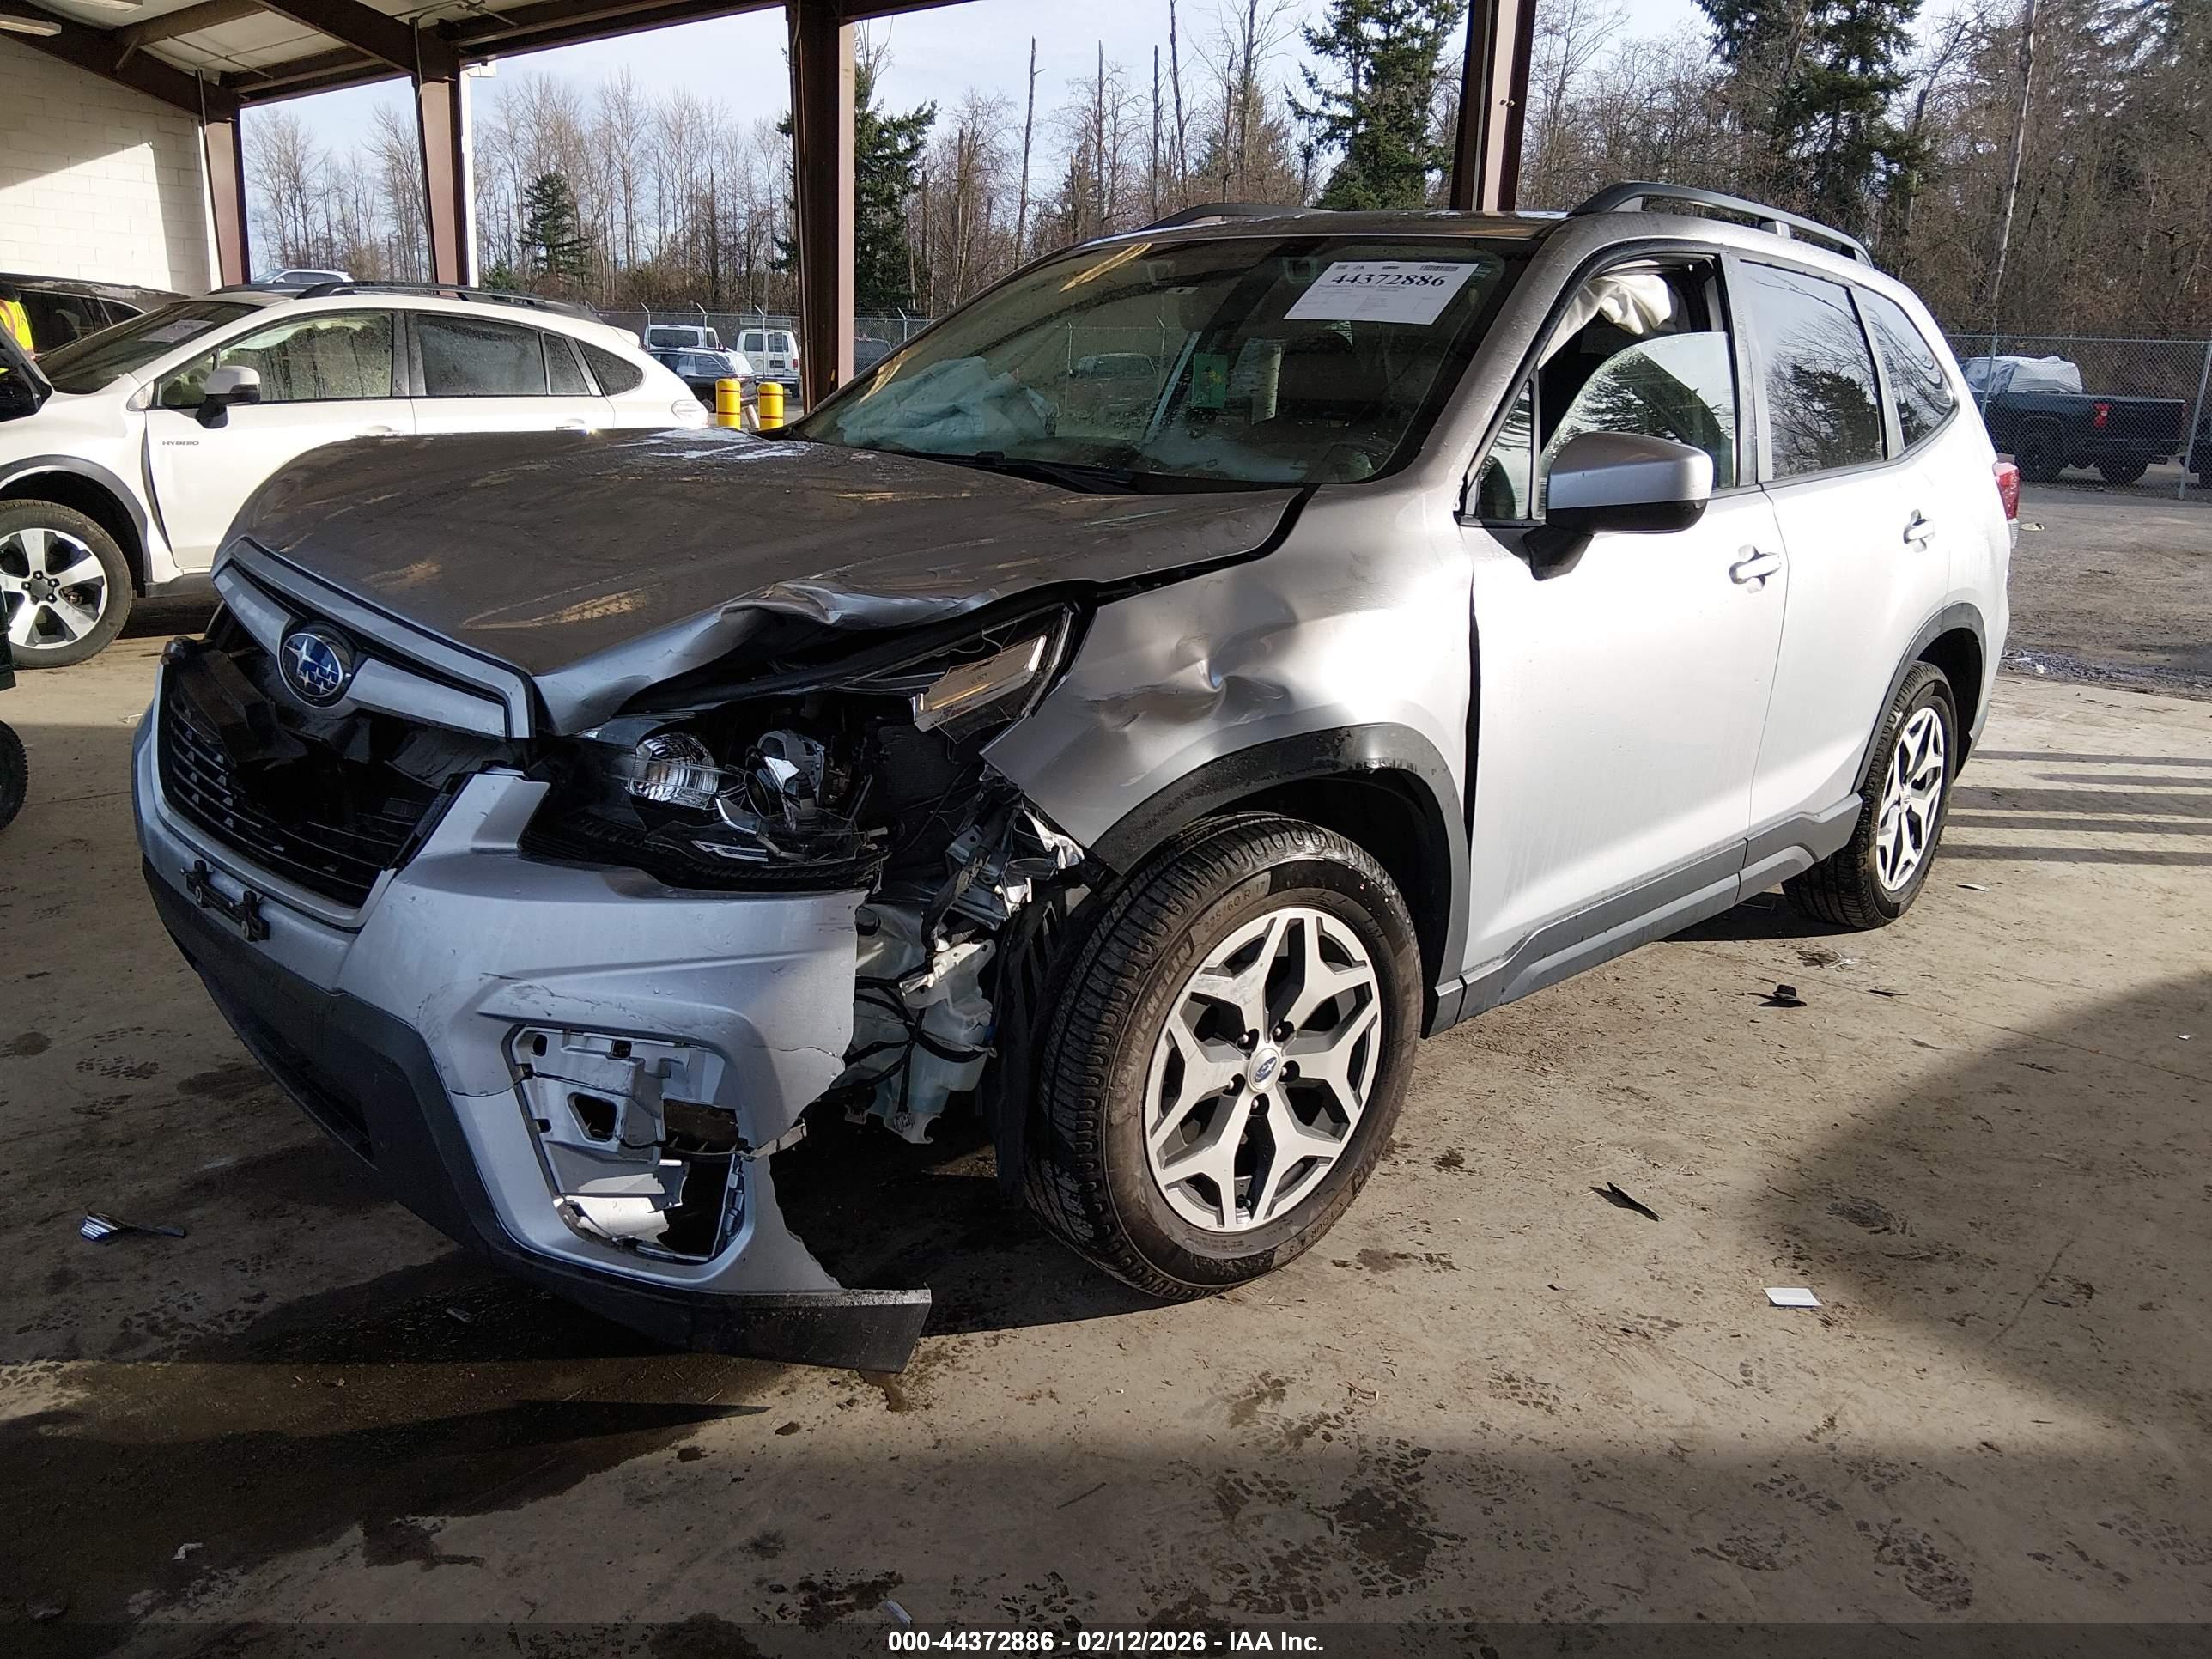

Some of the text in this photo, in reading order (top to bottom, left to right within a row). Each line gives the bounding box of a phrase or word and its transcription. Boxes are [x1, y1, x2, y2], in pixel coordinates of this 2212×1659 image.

[1331, 273, 1450, 287] 44372886
[1243, 889, 1251, 901] R
[1127, 939, 1194, 1064] MICHELIN
